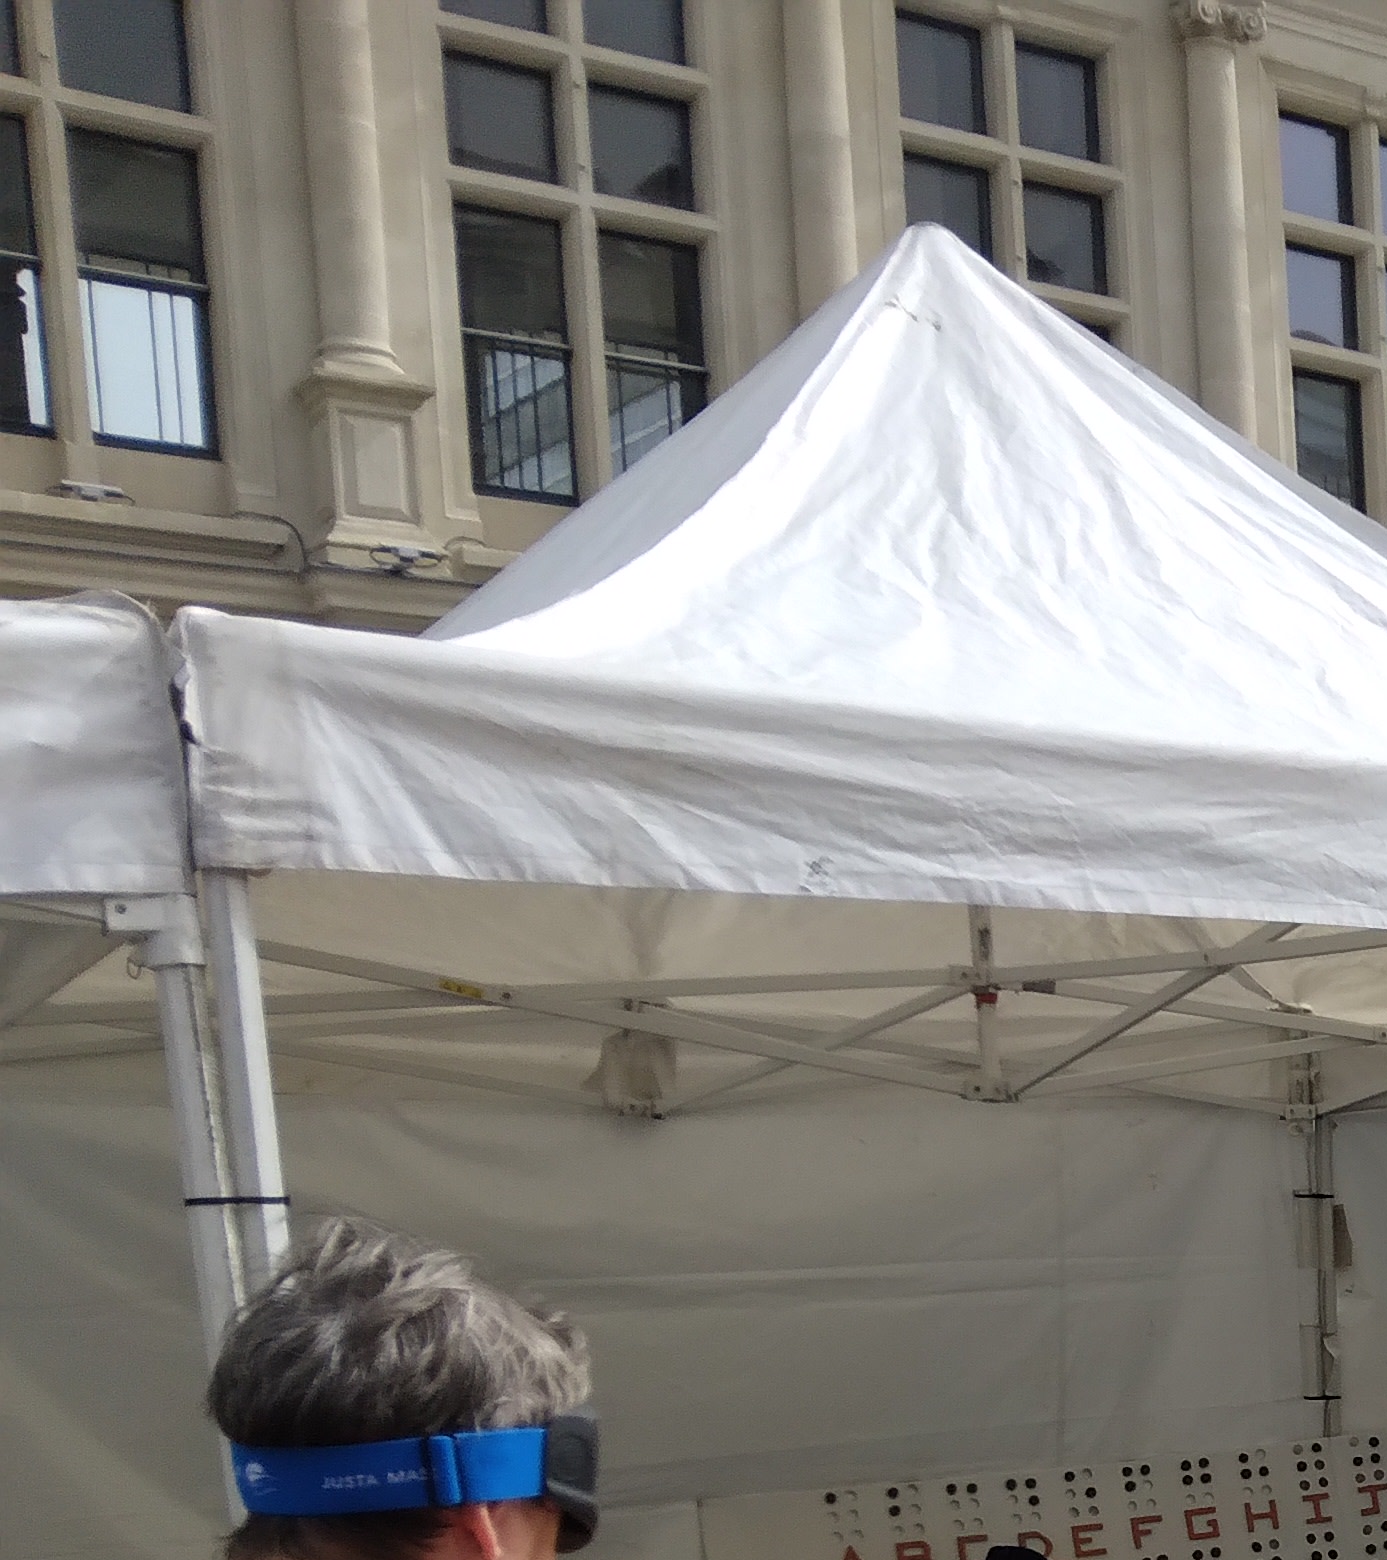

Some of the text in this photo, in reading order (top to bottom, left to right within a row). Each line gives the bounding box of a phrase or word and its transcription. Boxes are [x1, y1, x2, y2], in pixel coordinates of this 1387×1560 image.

[1071, 1523, 1107, 1558] E
[1129, 1514, 1163, 1550] F
[1183, 1506, 1221, 1541] G
[1244, 1499, 1280, 1533] H
[1302, 1492, 1333, 1525] I
